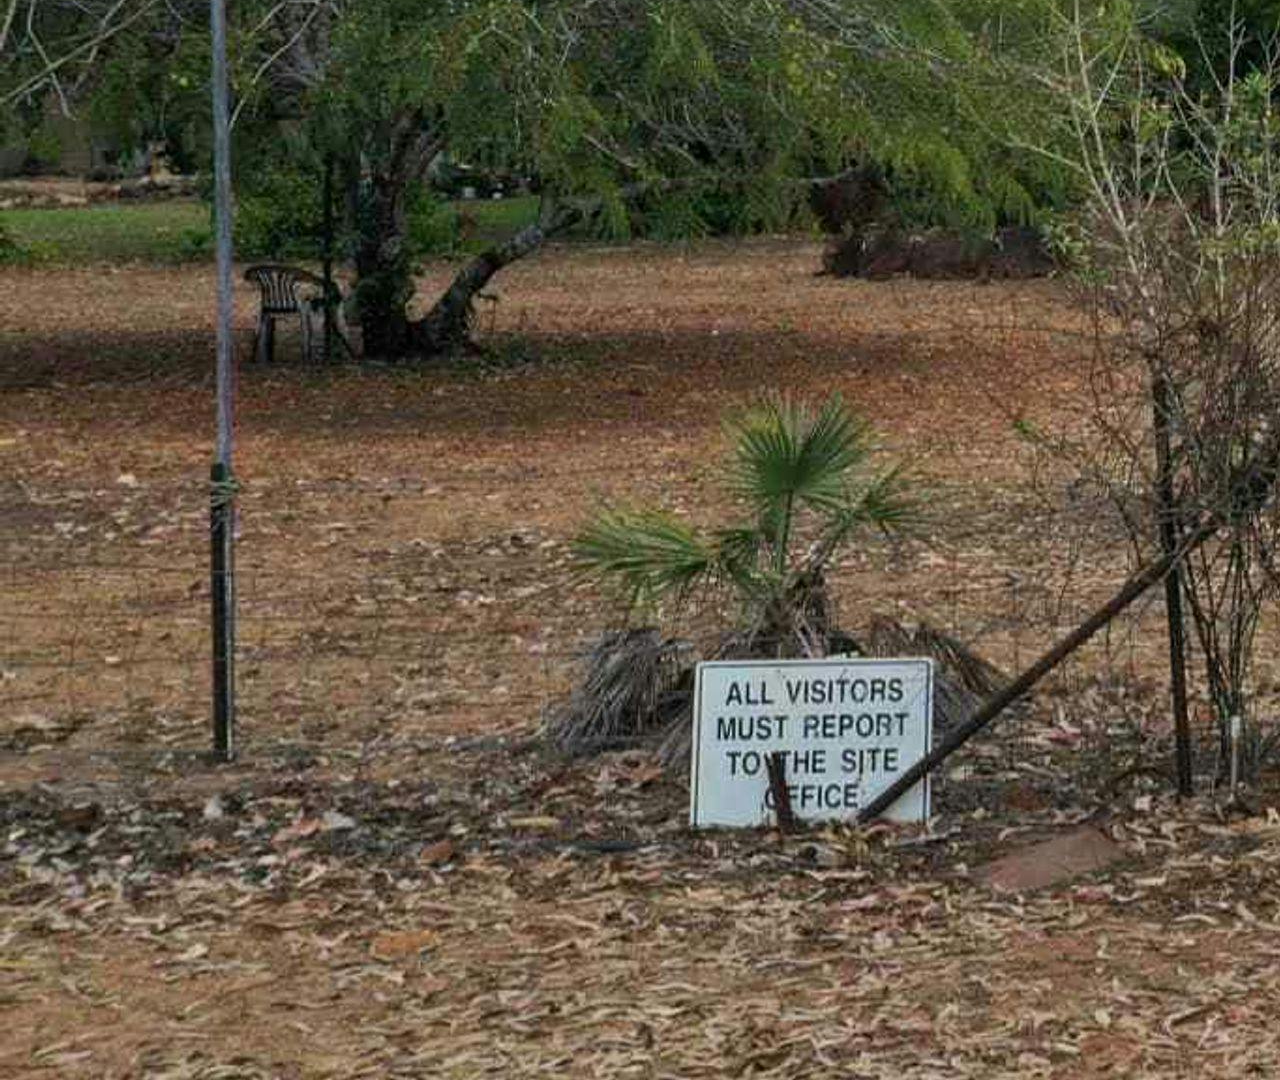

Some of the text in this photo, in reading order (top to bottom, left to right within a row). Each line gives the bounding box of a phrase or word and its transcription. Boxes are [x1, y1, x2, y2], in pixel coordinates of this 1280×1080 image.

[726, 678, 904, 706] ALL VISITORS
[716, 713, 910, 740] MUST REPORT
[726, 748, 898, 775] TO THE SITE
